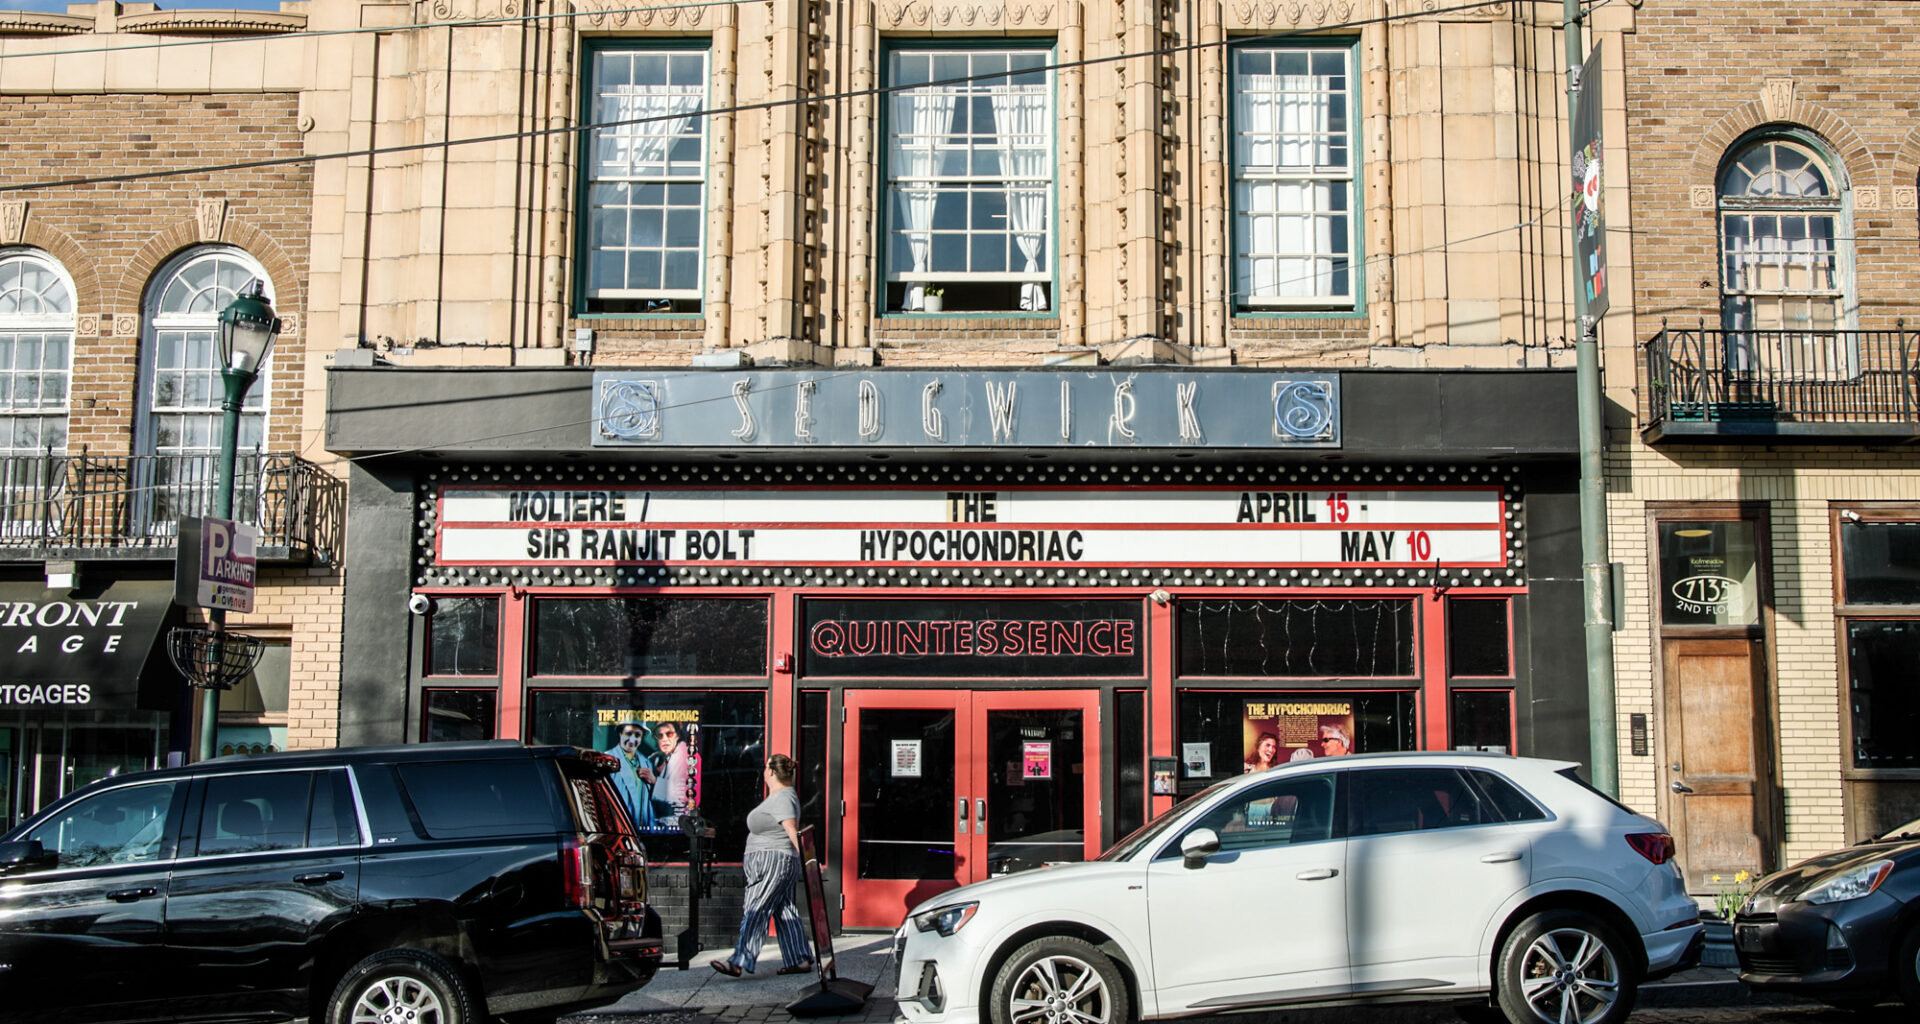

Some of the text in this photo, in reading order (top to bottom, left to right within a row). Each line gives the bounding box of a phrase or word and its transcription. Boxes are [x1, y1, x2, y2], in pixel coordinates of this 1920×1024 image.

[732, 379, 1200, 439] SEDGWICK
[510, 492, 625, 522] MOLIERE
[949, 492, 998, 522] THE
[1237, 492, 1316, 523] APRIL
[1325, 492, 1350, 522] 15
[208, 522, 252, 583] PARKING
[528, 530, 755, 560] SIR RANJIT BOLT
[861, 530, 1084, 561] HYPOCHONDRIAC
[1341, 531, 1431, 562] MAY 10
[222, 596, 247, 609] avenue
[1676, 600, 1702, 614] 2ND
[811, 619, 1136, 657] QUINTESSENCE
[0, 684, 91, 704] TGAGES
[597, 709, 699, 722] THE HYPOCHONDRIAC
[1246, 703, 1351, 716] THE HYPOCHONDRIAC
